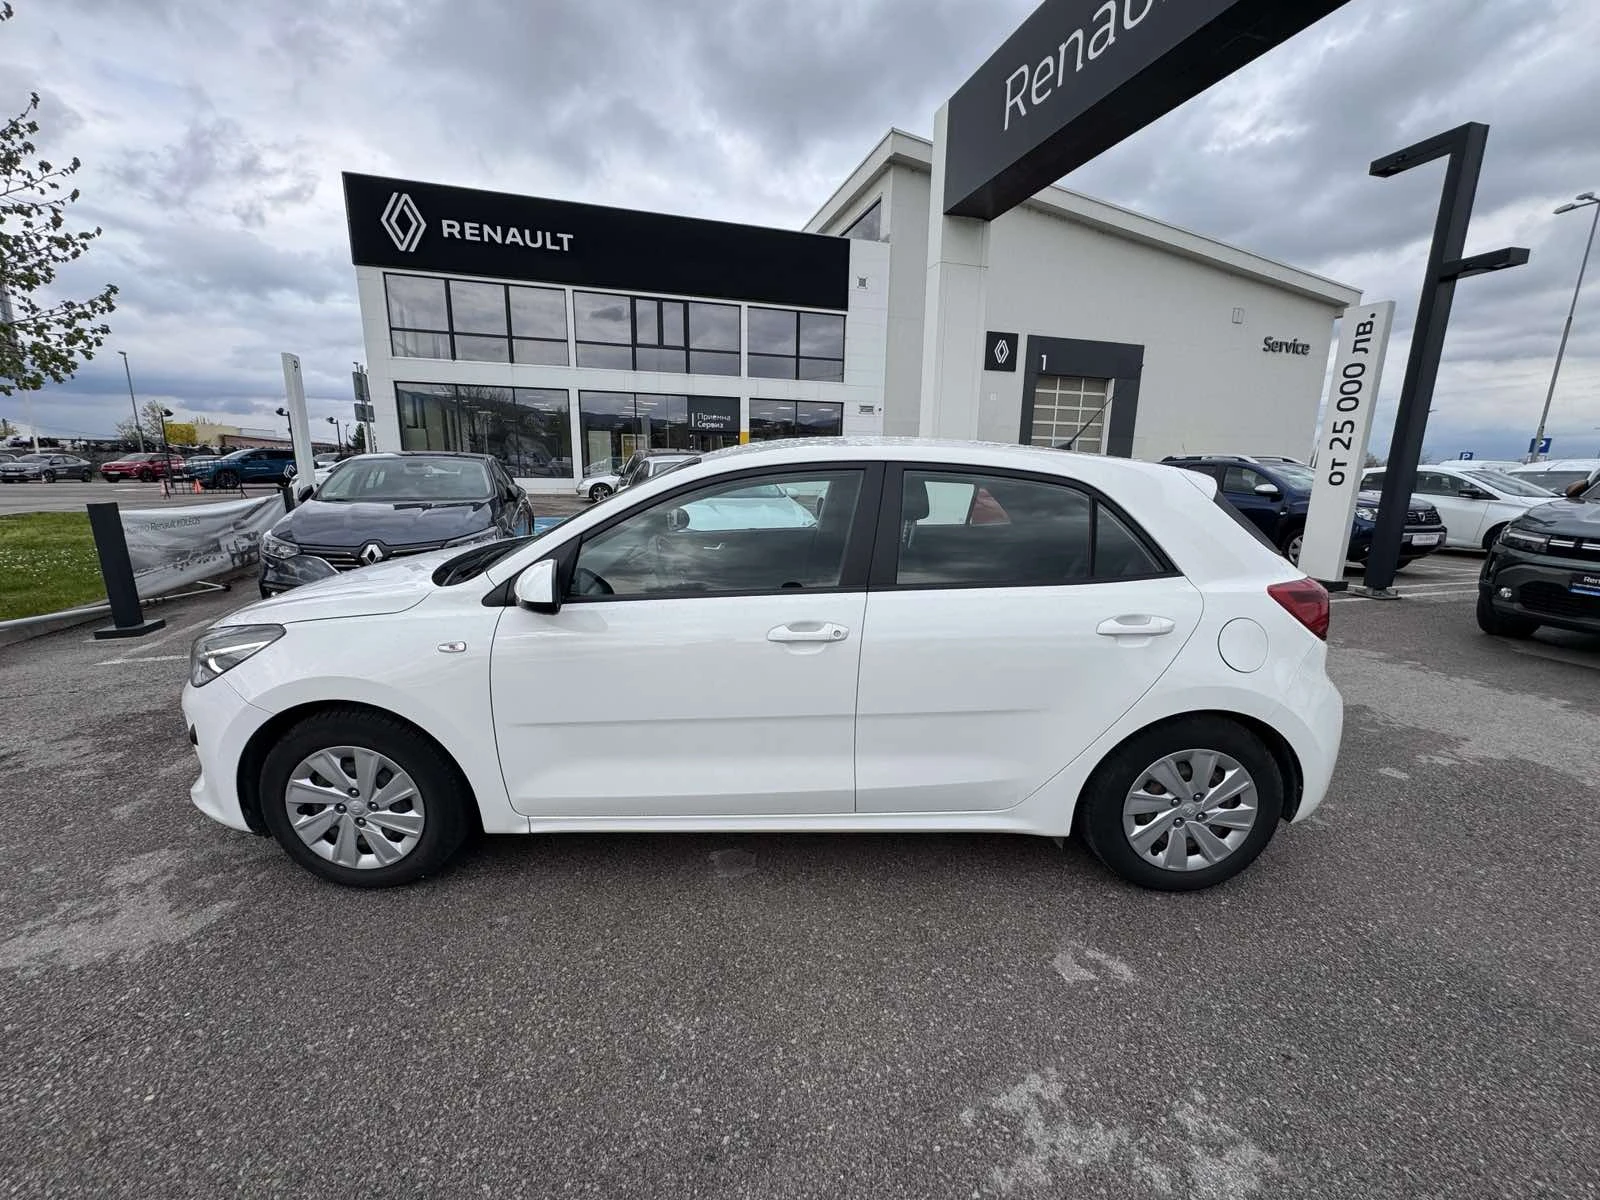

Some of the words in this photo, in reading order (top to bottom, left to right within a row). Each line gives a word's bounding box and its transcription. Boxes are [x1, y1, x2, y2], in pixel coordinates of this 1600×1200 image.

[1003, 0, 1166, 131] Renau
[441, 219, 574, 252] RENAULT
[1262, 335, 1311, 356] Service
[1352, 312, 1377, 354] лв.
[1041, 354, 1048, 371] 1
[1336, 362, 1366, 412] 000
[1329, 420, 1355, 450] 25
[1328, 458, 1348, 486] от
[1462, 453, 1471, 461] P
